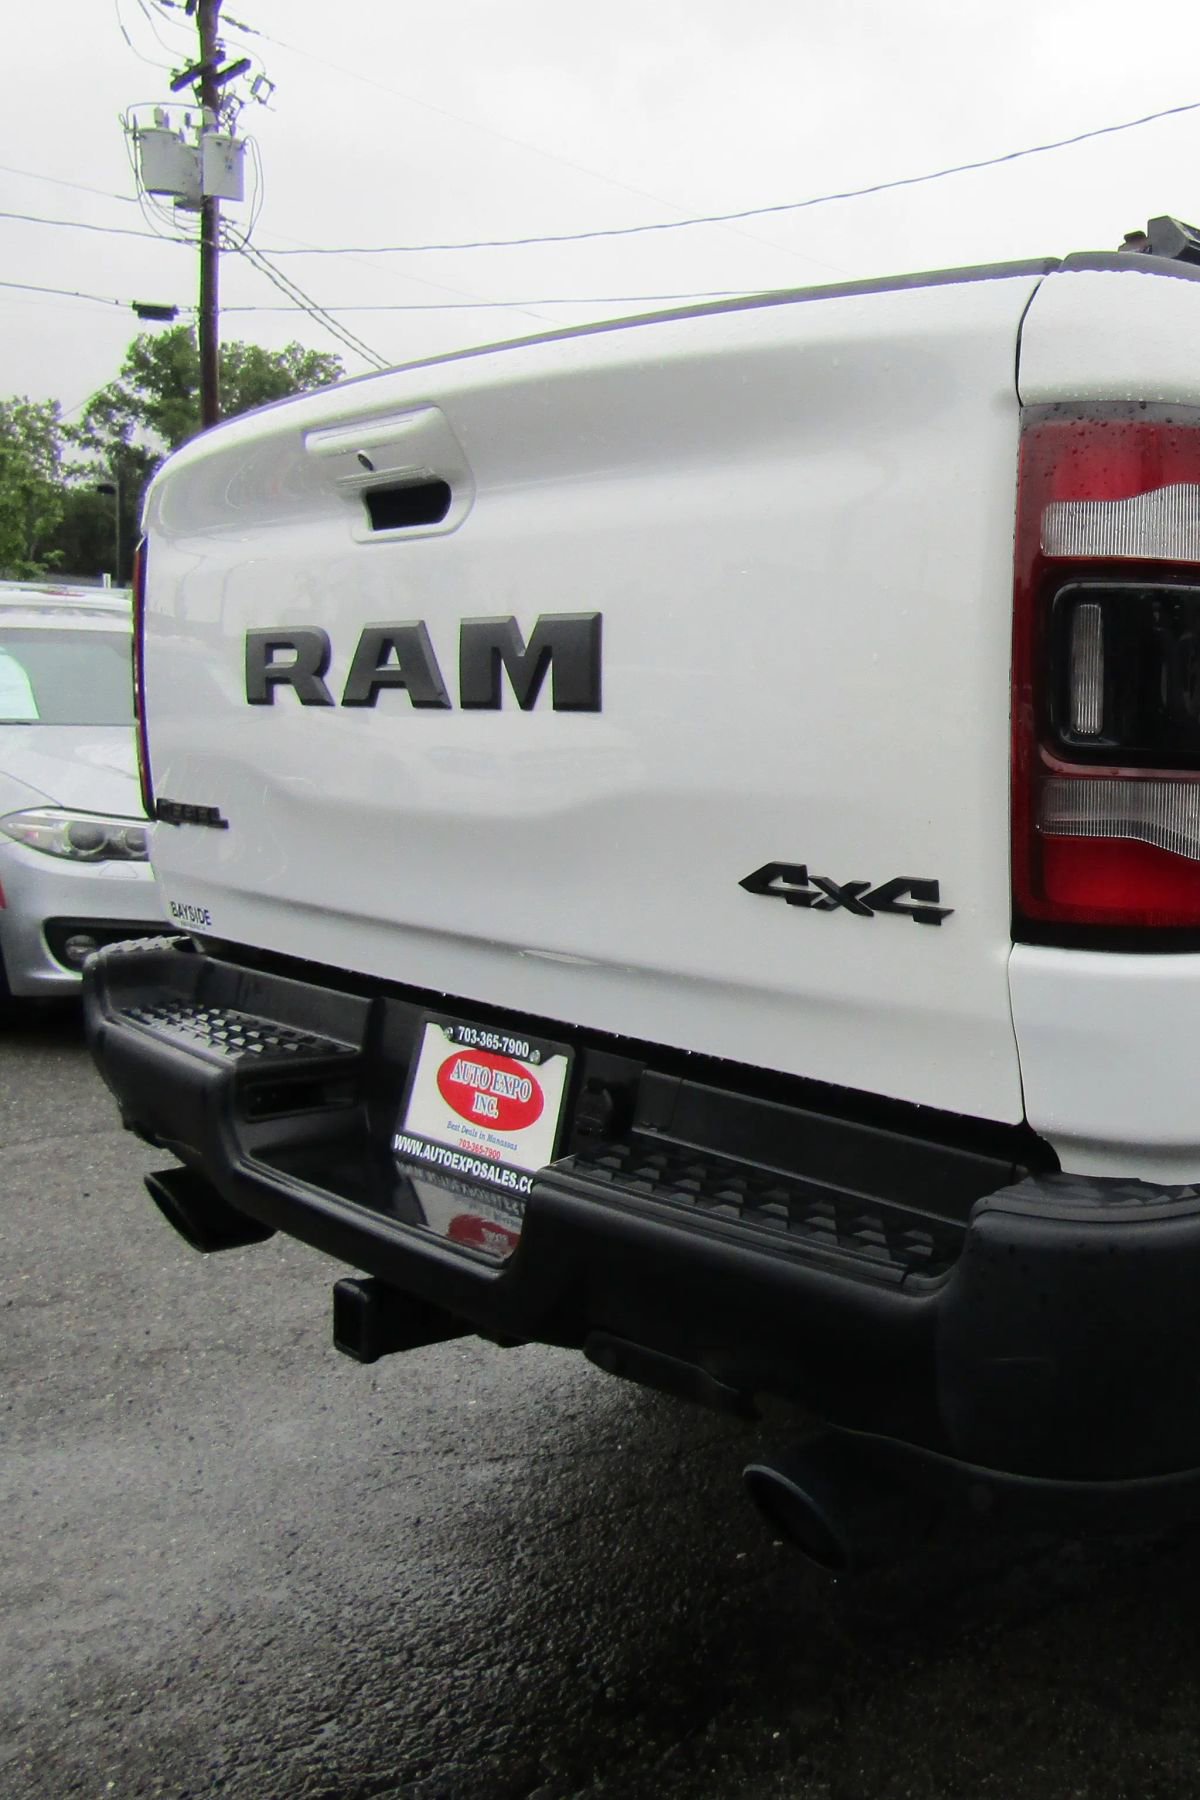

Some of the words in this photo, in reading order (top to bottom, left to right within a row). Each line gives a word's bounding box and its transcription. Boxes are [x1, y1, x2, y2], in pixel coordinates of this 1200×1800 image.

[246, 612, 602, 712] RAM
[170, 901, 212, 926] BAYSIDE
[458, 1026, 530, 1058] 703-365-7900
[450, 1059, 492, 1090] AUTO
[491, 1069, 533, 1102] EXPO
[472, 1092, 499, 1118] INC.
[446, 1120, 461, 1132] Best
[479, 1131, 486, 1140] in
[458, 1138, 502, 1160] 703-365-7900
